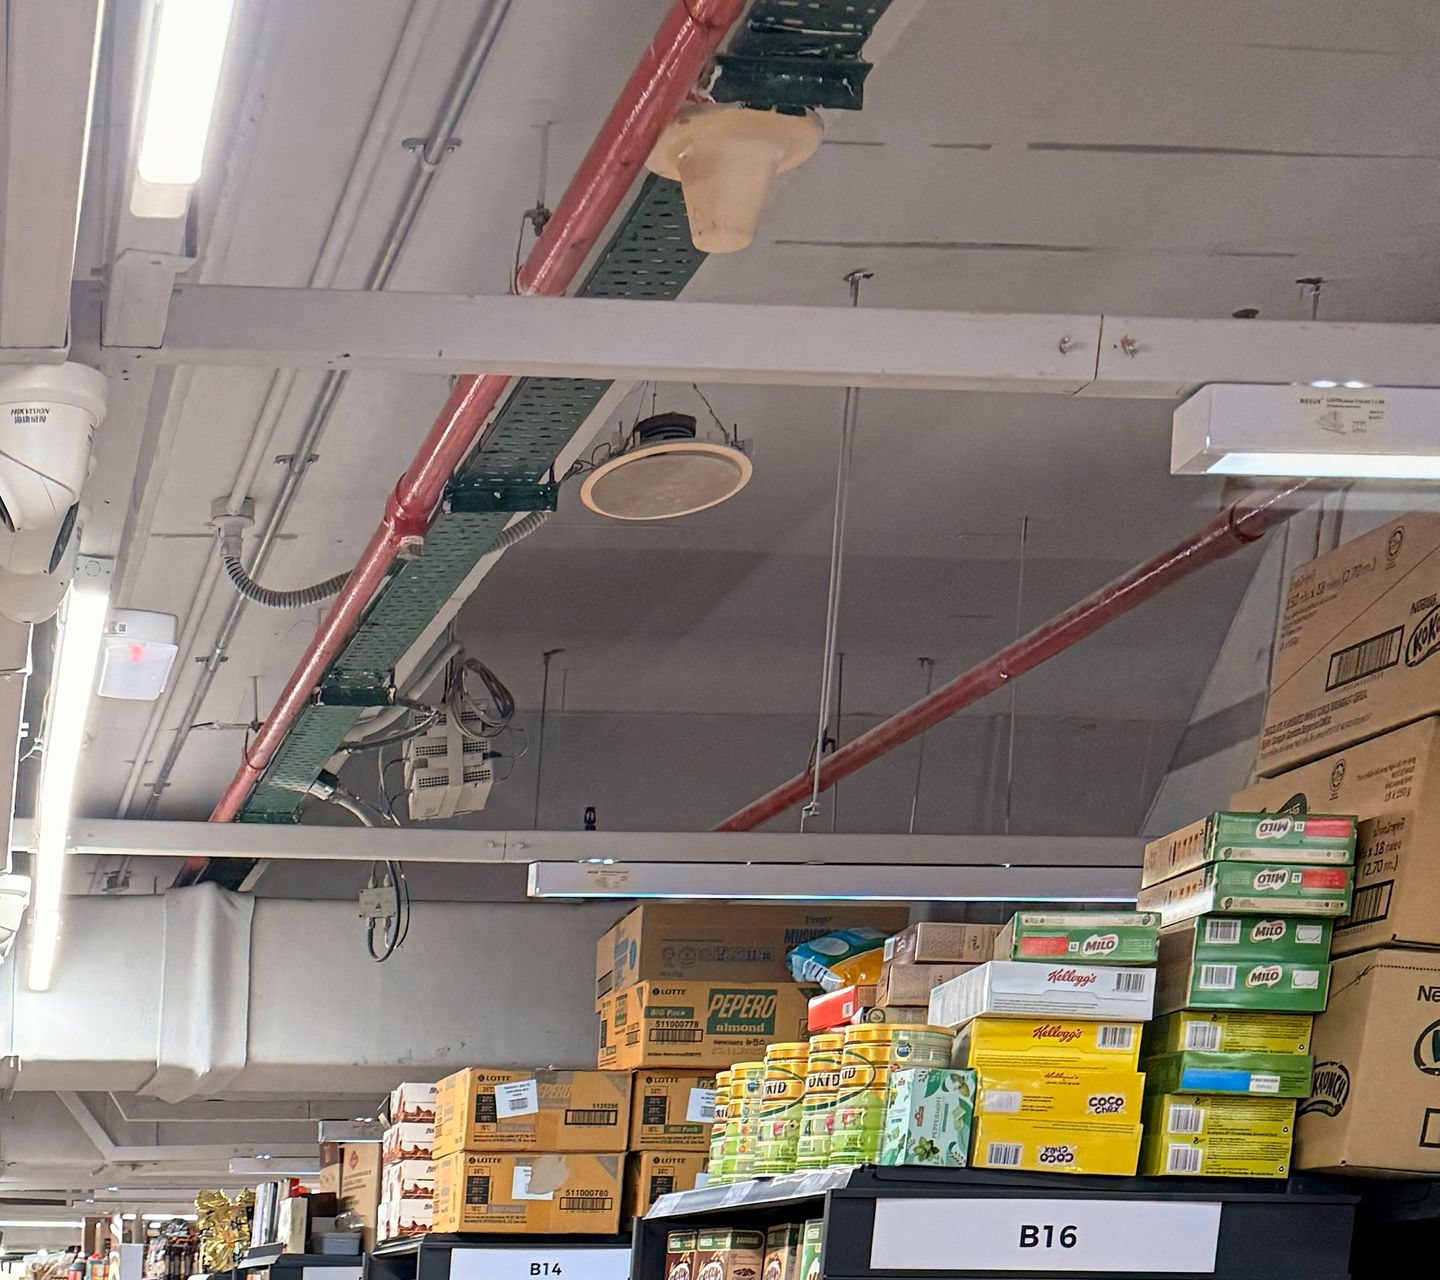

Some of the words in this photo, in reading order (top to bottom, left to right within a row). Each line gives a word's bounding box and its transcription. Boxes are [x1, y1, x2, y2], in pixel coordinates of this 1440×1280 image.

[1254, 923, 1284, 940] MILO
[1084, 938, 1116, 954] MILO
[1047, 968, 1098, 987] Kellogg's
[1249, 969, 1280, 984] MILO
[660, 988, 688, 997] LOTTE
[709, 994, 776, 1019] PEPERO
[715, 1021, 766, 1034] almond
[1033, 1025, 1083, 1042] Kellogg's
[485, 1074, 512, 1083] LOTTE
[653, 1076, 681, 1085] LOTTE
[1088, 1095, 1124, 1109] COCO
[475, 1157, 503, 1166] LOTTE
[659, 1156, 687, 1165] LOTTE
[1019, 1224, 1078, 1248] B16
[529, 1261, 562, 1277] B14
